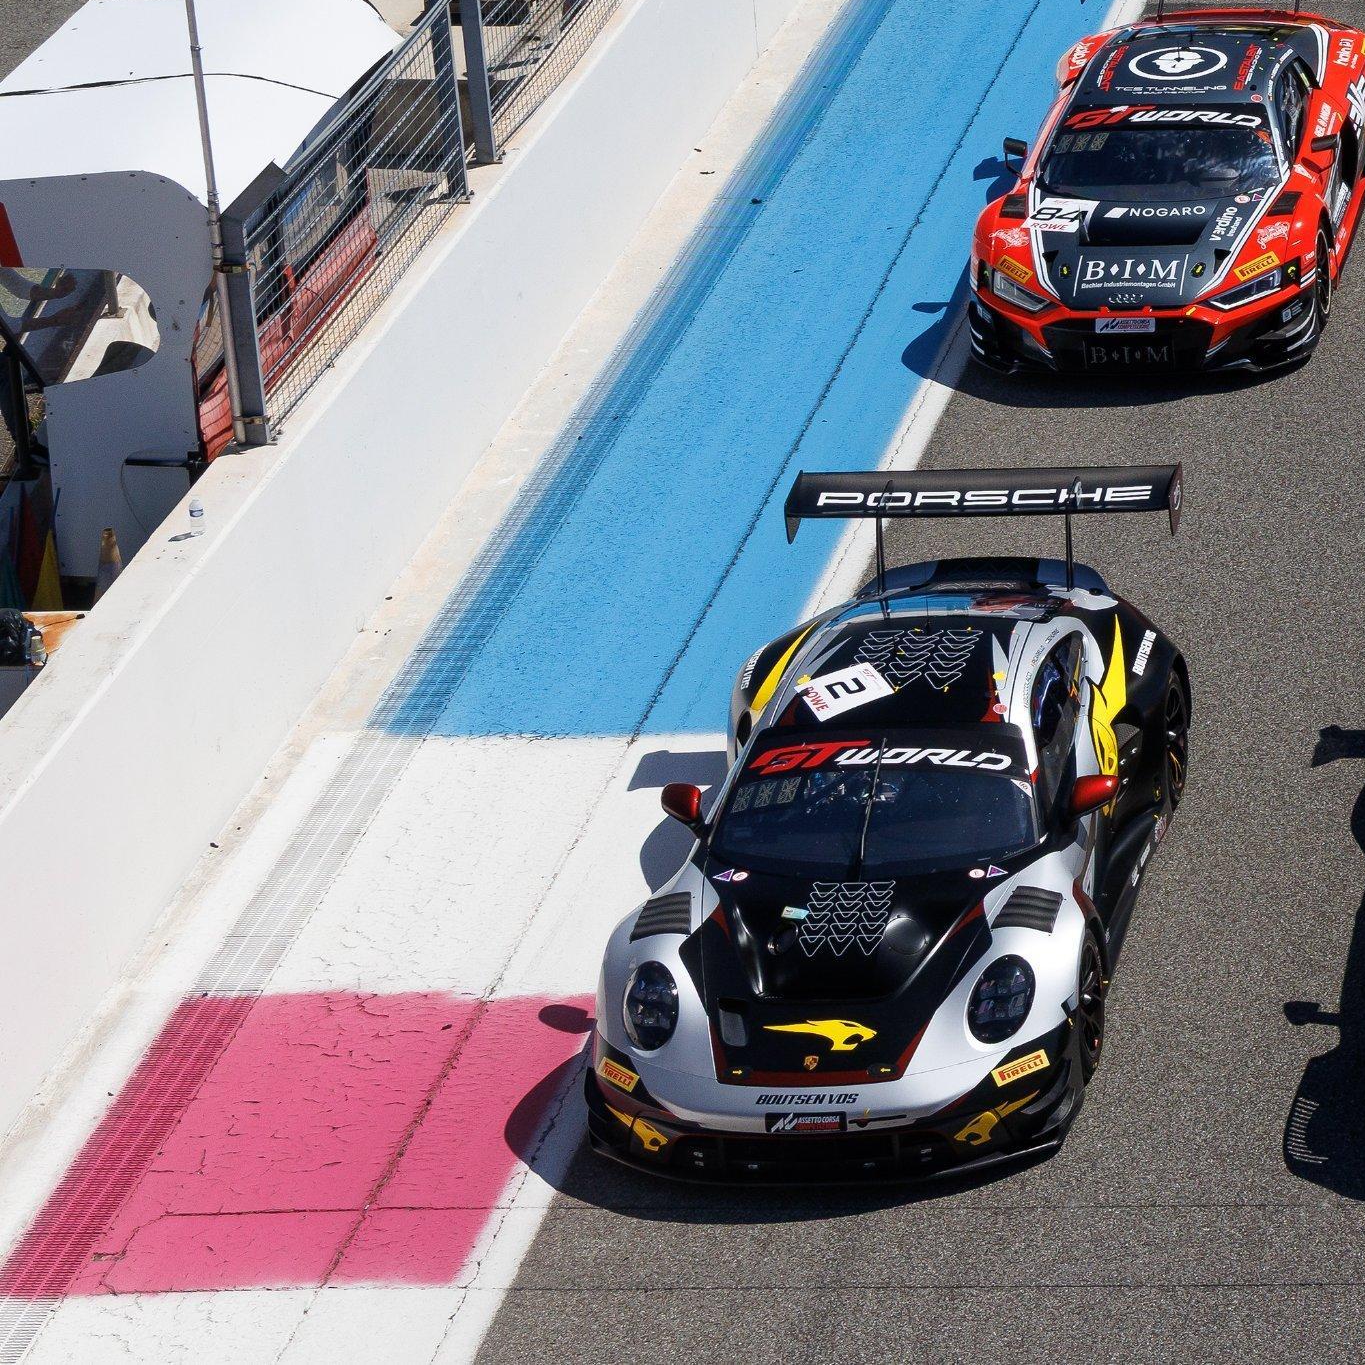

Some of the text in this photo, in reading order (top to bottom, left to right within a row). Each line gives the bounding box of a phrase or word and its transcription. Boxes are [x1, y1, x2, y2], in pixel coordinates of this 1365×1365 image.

[1030, 204, 1086, 221] 84
[1129, 205, 1206, 217] NOGARO
[1028, 222, 1070, 232] ROWE
[1001, 257, 1031, 281] PIRELLI
[1239, 256, 1276, 278] PIRELLI
[1157, 281, 1176, 289] GmbH
[816, 486, 1153, 507] PORSCHE
[802, 685, 831, 713] ROWE
[824, 677, 869, 700] 2
[997, 1054, 1047, 1082] PIRELLI
[756, 1094, 859, 1104] BOUTSEN VDS
